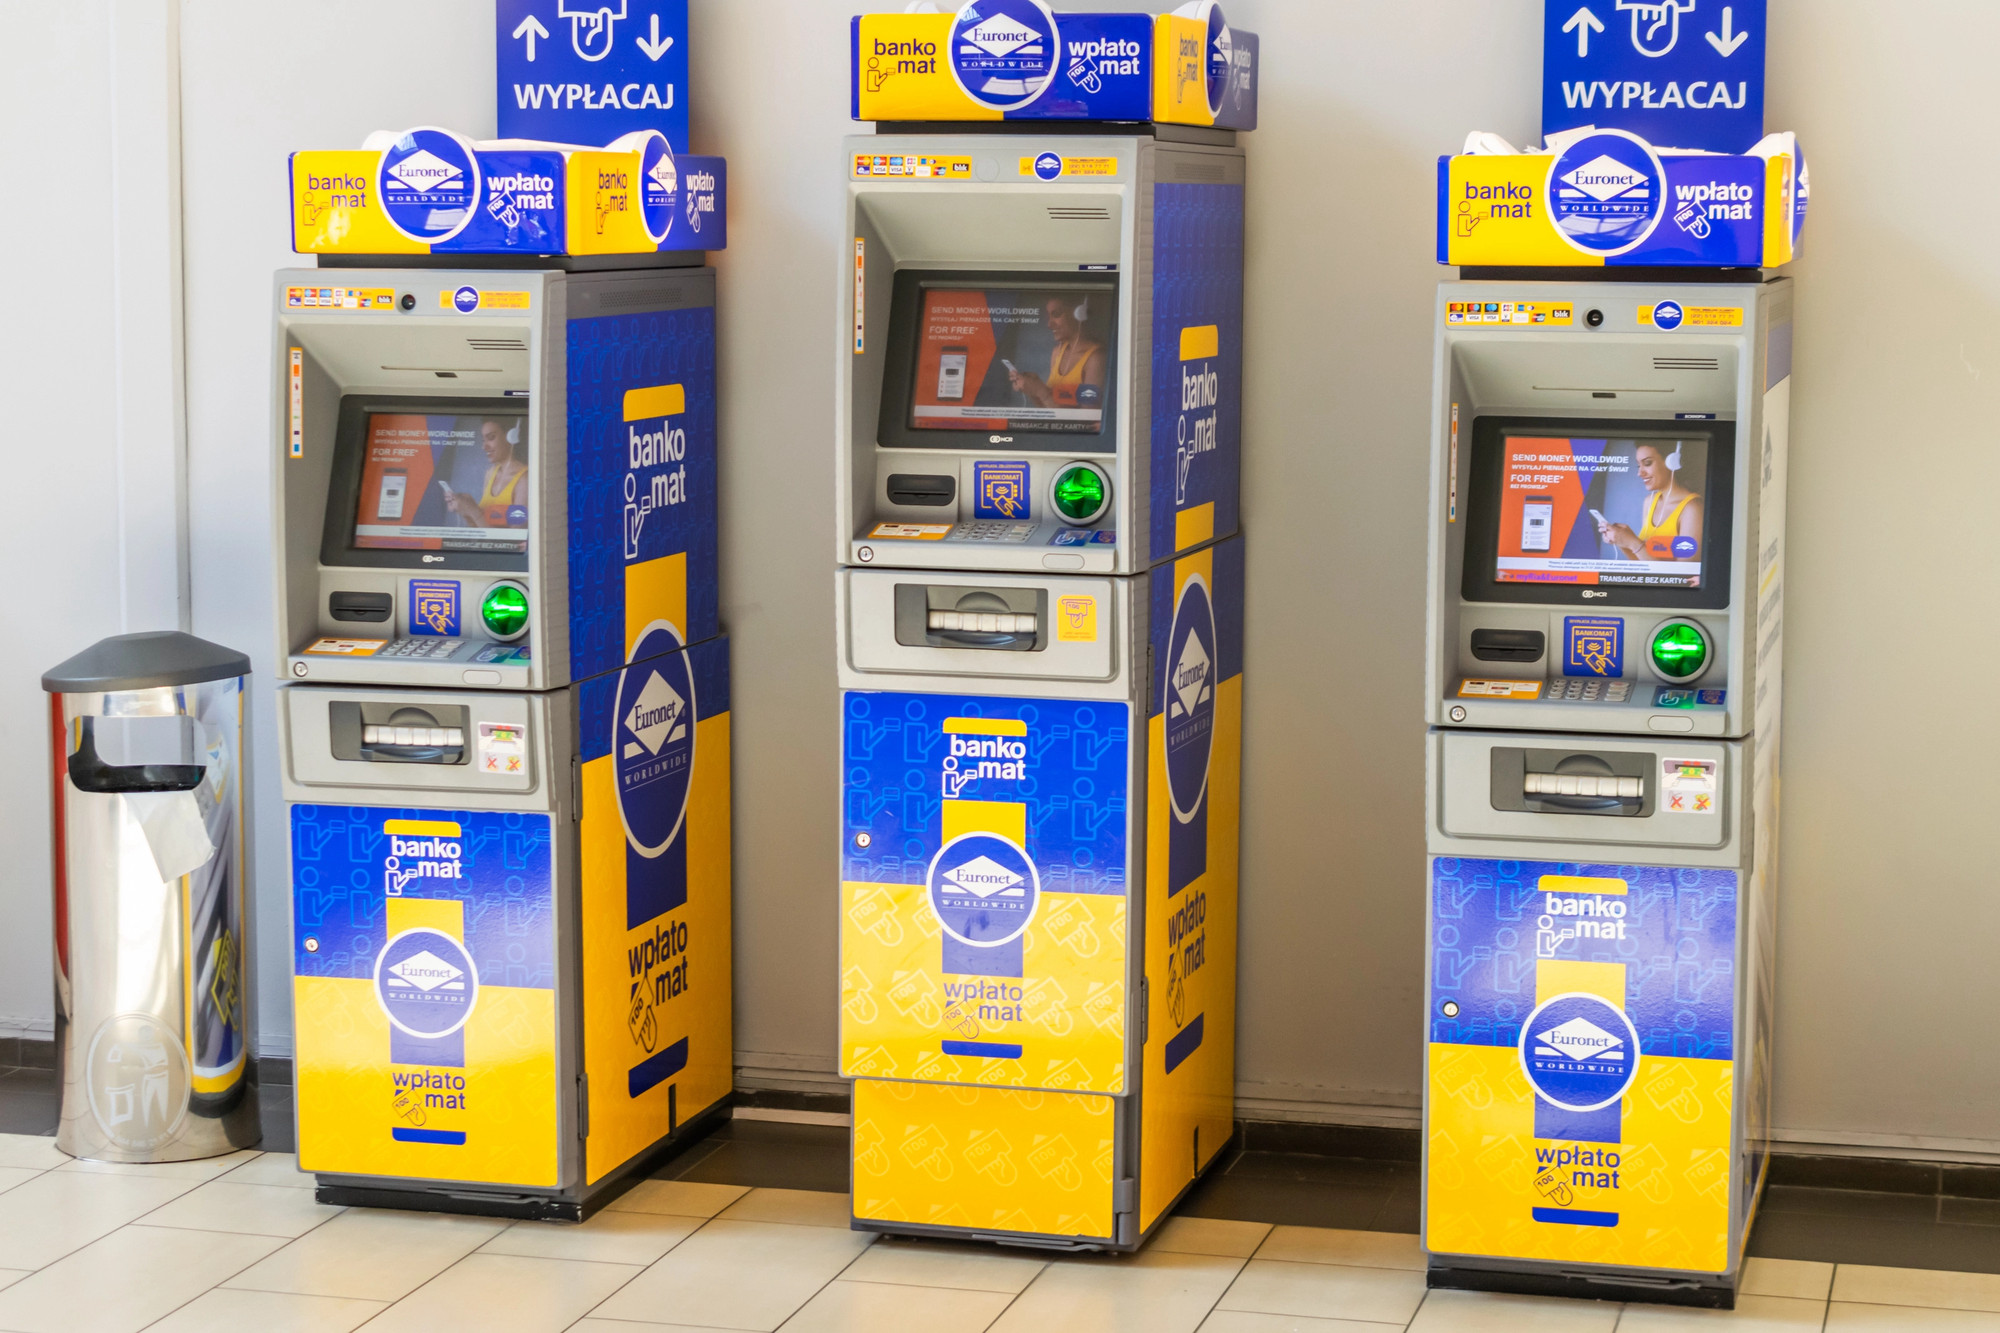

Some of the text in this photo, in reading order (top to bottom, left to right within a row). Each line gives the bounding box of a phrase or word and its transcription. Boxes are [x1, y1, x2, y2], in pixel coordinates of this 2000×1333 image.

[974, 28, 1029, 42] Euronet
[874, 38, 936, 56] banko
[1068, 38, 1140, 58] wpłato
[898, 57, 936, 74] mat
[1071, 65, 1086, 78] 100
[1101, 58, 1140, 75] mat
[513, 83, 674, 110] WYPŁACAJ
[1562, 81, 1747, 109] WYPŁACAJ
[399, 164, 449, 178] Euronet
[598, 168, 628, 189] banko
[1575, 171, 1634, 185] Euronet
[308, 173, 367, 191] banko
[487, 173, 554, 192] wpłato
[686, 170, 715, 192] wpłato
[1465, 181, 1532, 200] banko
[331, 191, 367, 209] mat
[517, 193, 554, 209] mat
[609, 191, 628, 211] mat
[1675, 181, 1753, 202] wpłato
[490, 200, 505, 212] 100
[698, 193, 715, 212] mat
[1490, 200, 1532, 219] mat
[1708, 201, 1753, 220] mat
[1677, 209, 1694, 223] 100
[931, 306, 954, 314] SEND
[988, 307, 1039, 315] WORLDWIDE
[929, 326, 948, 334] FOR
[1182, 362, 1218, 411] banko
[428, 430, 476, 438] WORLDWIDE
[1008, 422, 1049, 430] TRANSAKCJE
[1065, 423, 1086, 431] KARTY
[1194, 410, 1217, 454] mat
[373, 448, 391, 456] FOR
[629, 420, 686, 470] banko
[1512, 453, 1629, 464] SEND MONEY WORLDWIDE
[651, 464, 686, 509] mat
[1510, 474, 1532, 482] FOR
[1600, 575, 1682, 585] TRANSAKCJE BEZ KARTY
[1178, 660, 1205, 692] Euronet
[634, 699, 677, 733] Euronet
[950, 734, 1026, 760] banko
[625, 753, 688, 786] WORLDWIDE
[978, 759, 1026, 781] mat
[391, 835, 462, 860] banko
[417, 859, 462, 879] mat
[955, 868, 1010, 885] Euronet
[942, 899, 1025, 910] WORLDWIDE
[1546, 891, 1627, 919] banko
[1168, 889, 1206, 949] wpłato
[1575, 918, 1627, 941] mat
[628, 919, 688, 978] wpłato
[1184, 927, 1206, 980] mat
[400, 963, 452, 980] Euronet
[656, 955, 688, 1007] mat
[389, 992, 465, 1003] WORLDWIDE
[943, 979, 1024, 1003] wpłato
[631, 997, 643, 1025] 100
[945, 1008, 962, 1021] 100
[979, 1001, 1024, 1022] mat
[1550, 1030, 1610, 1048] Euronet
[1535, 1061, 1625, 1074] WORLDWIDE
[392, 1069, 466, 1092] wpłato
[425, 1092, 466, 1110] mat
[1535, 1146, 1621, 1169] wpłato
[1537, 1174, 1555, 1188] 100
[1573, 1170, 1620, 1190] mat
